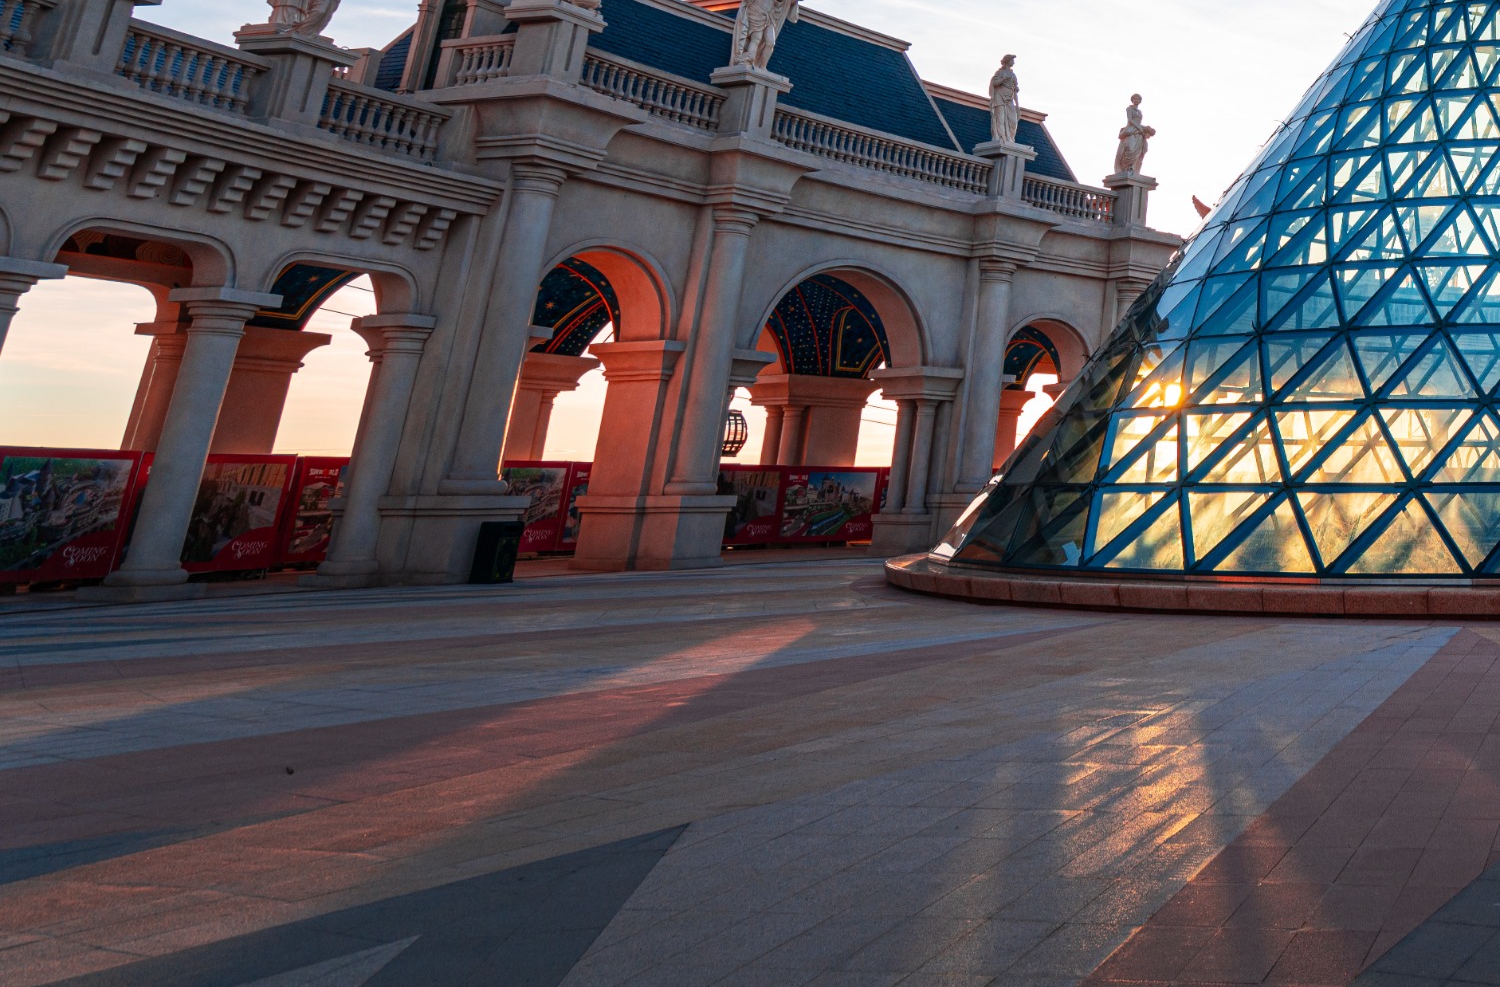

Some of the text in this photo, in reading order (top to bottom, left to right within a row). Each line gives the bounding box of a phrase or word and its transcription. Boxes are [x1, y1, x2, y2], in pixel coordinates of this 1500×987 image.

[231, 540, 269, 551] COMING
[63, 546, 108, 558] COMING
[65, 554, 100, 567] SOON
